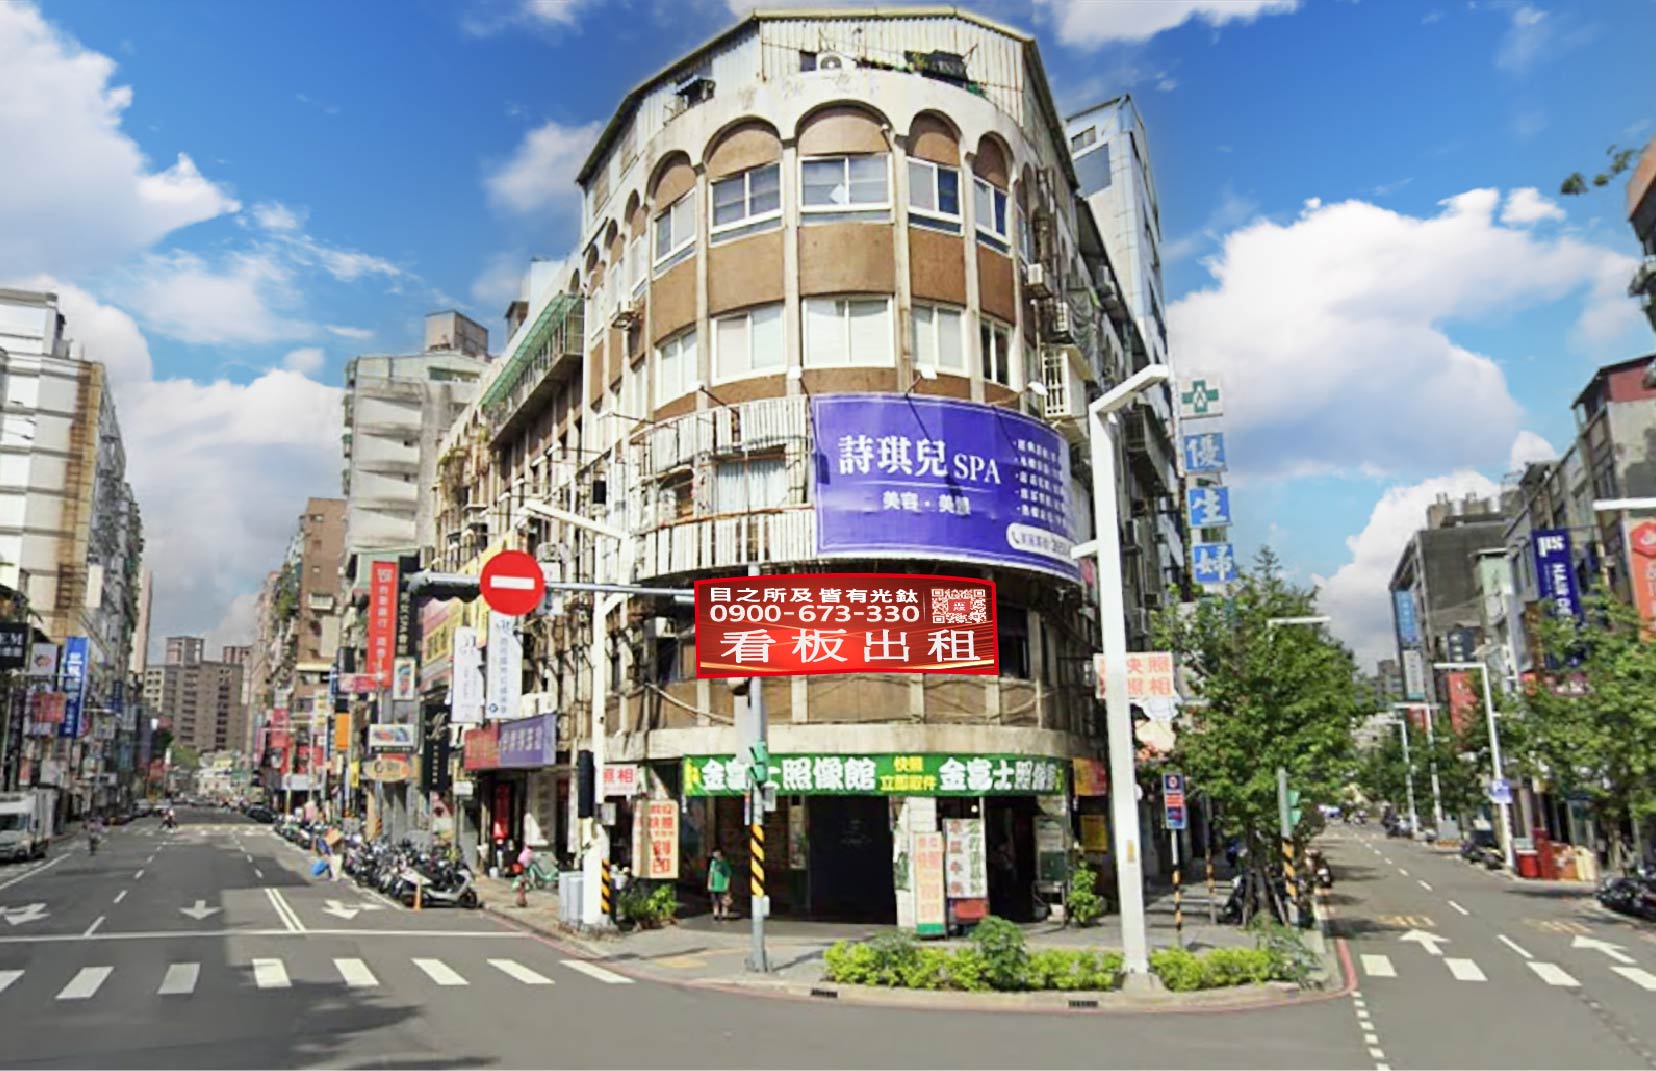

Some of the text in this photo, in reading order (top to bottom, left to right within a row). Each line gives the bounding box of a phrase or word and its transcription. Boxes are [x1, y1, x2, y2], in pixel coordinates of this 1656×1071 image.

[838, 434, 948, 477] 詩琪兒
[953, 453, 1001, 484] SPA
[710, 605, 920, 622] 0900-673-330
[720, 629, 981, 663] 看板出租
